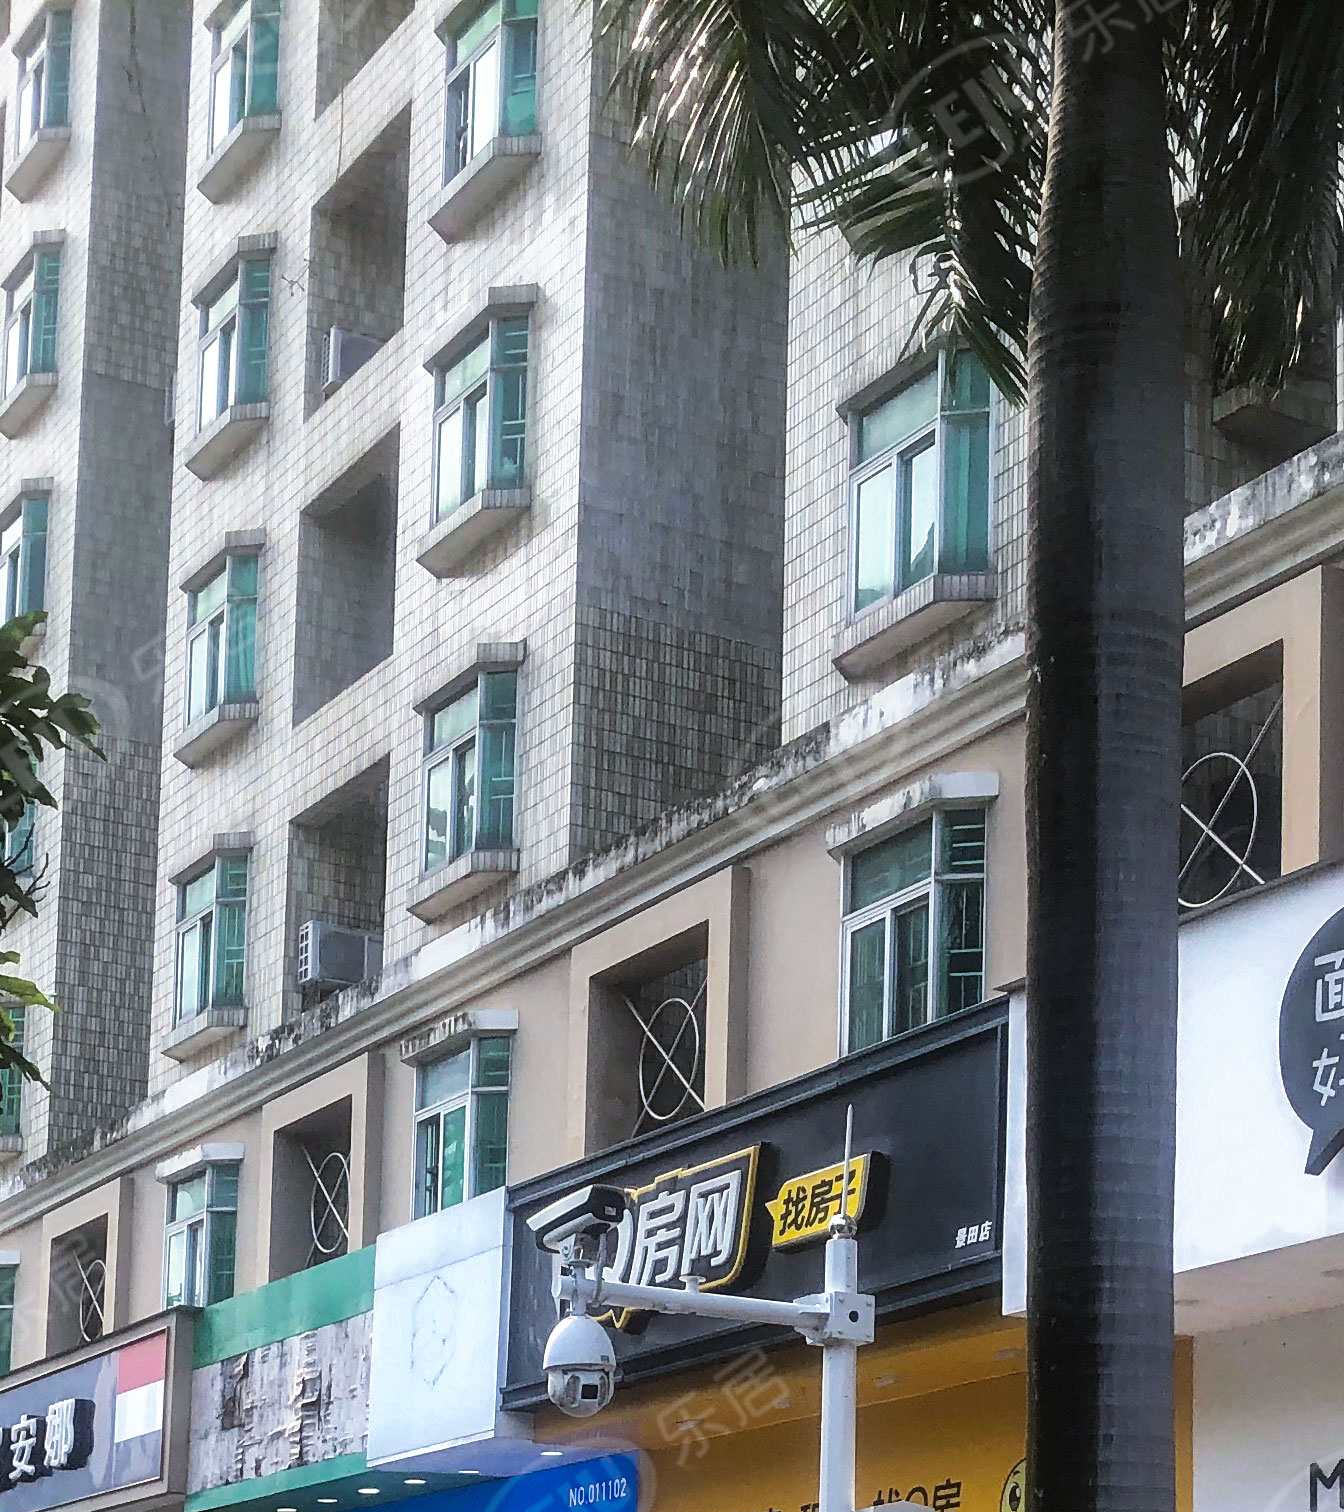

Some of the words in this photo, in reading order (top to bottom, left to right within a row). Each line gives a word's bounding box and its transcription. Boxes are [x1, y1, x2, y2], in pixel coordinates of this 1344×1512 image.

[778, 1168, 857, 1236] 找房子
[568, 1477, 628, 1508] NO.011102
